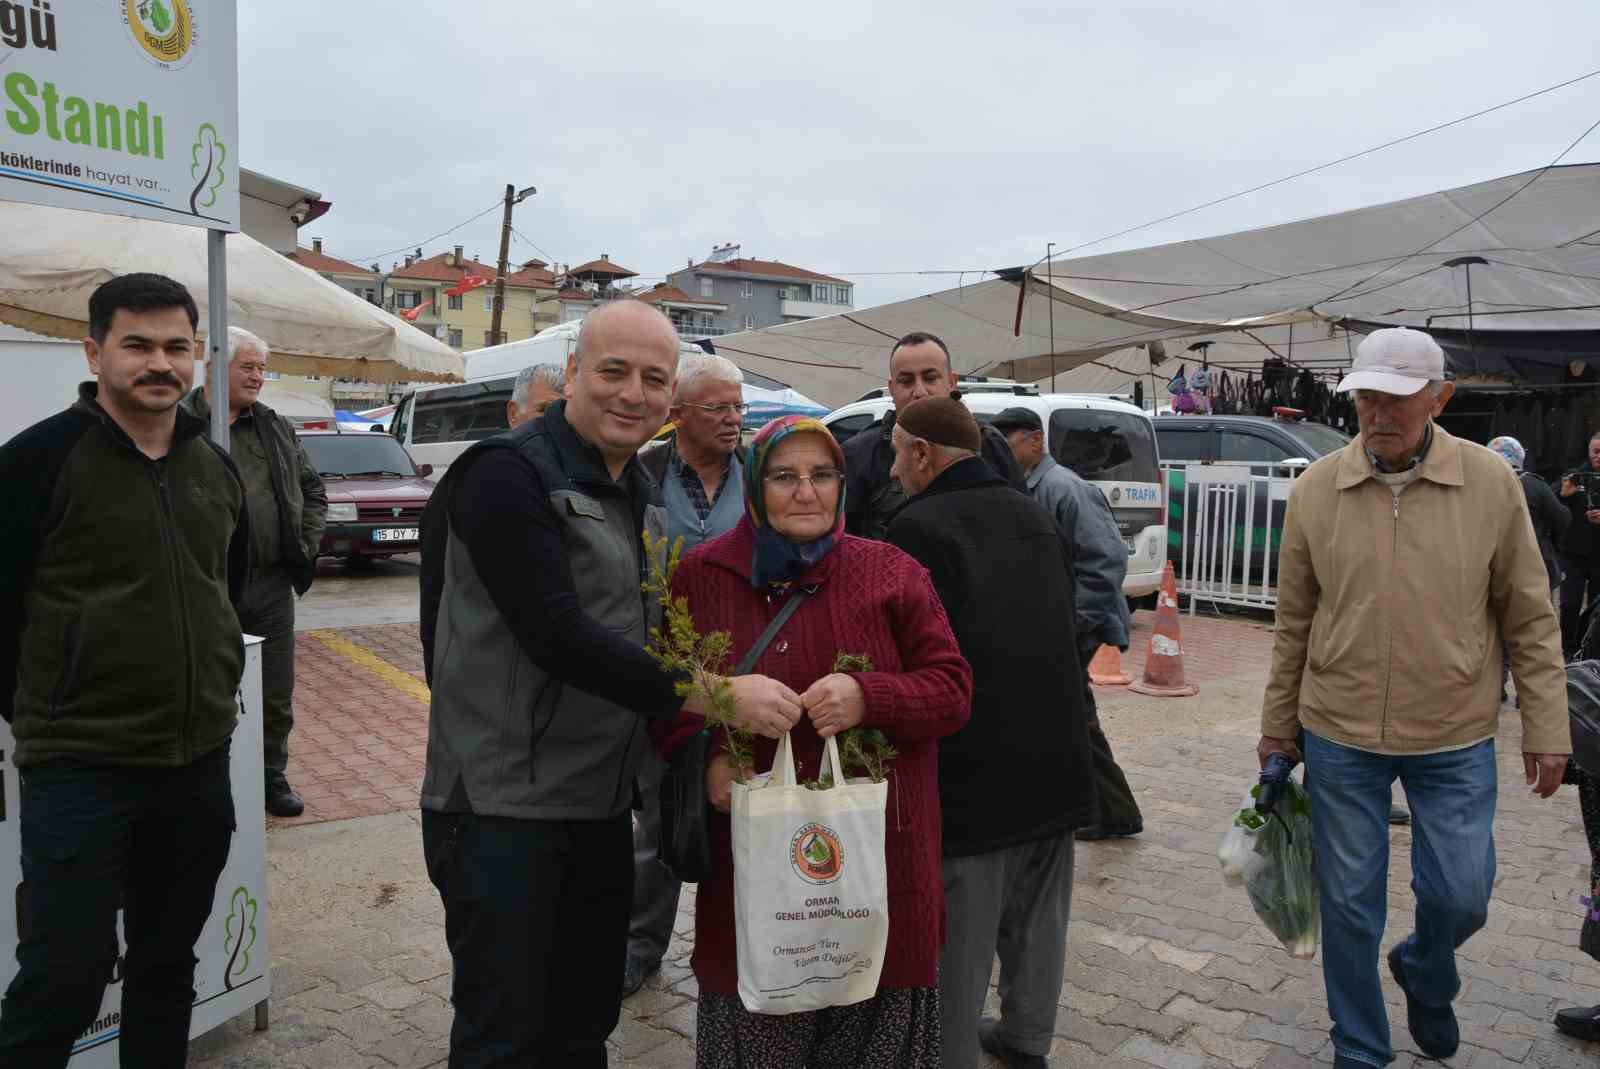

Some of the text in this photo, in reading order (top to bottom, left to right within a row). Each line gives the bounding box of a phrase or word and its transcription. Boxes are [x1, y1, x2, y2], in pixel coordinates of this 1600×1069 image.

[4, 72, 165, 160] Standı
[0, 151, 81, 178] köklerinde
[86, 166, 131, 186] hayat
[805, 896, 840, 907] ORMAN
[775, 911, 807, 921] GENEL
